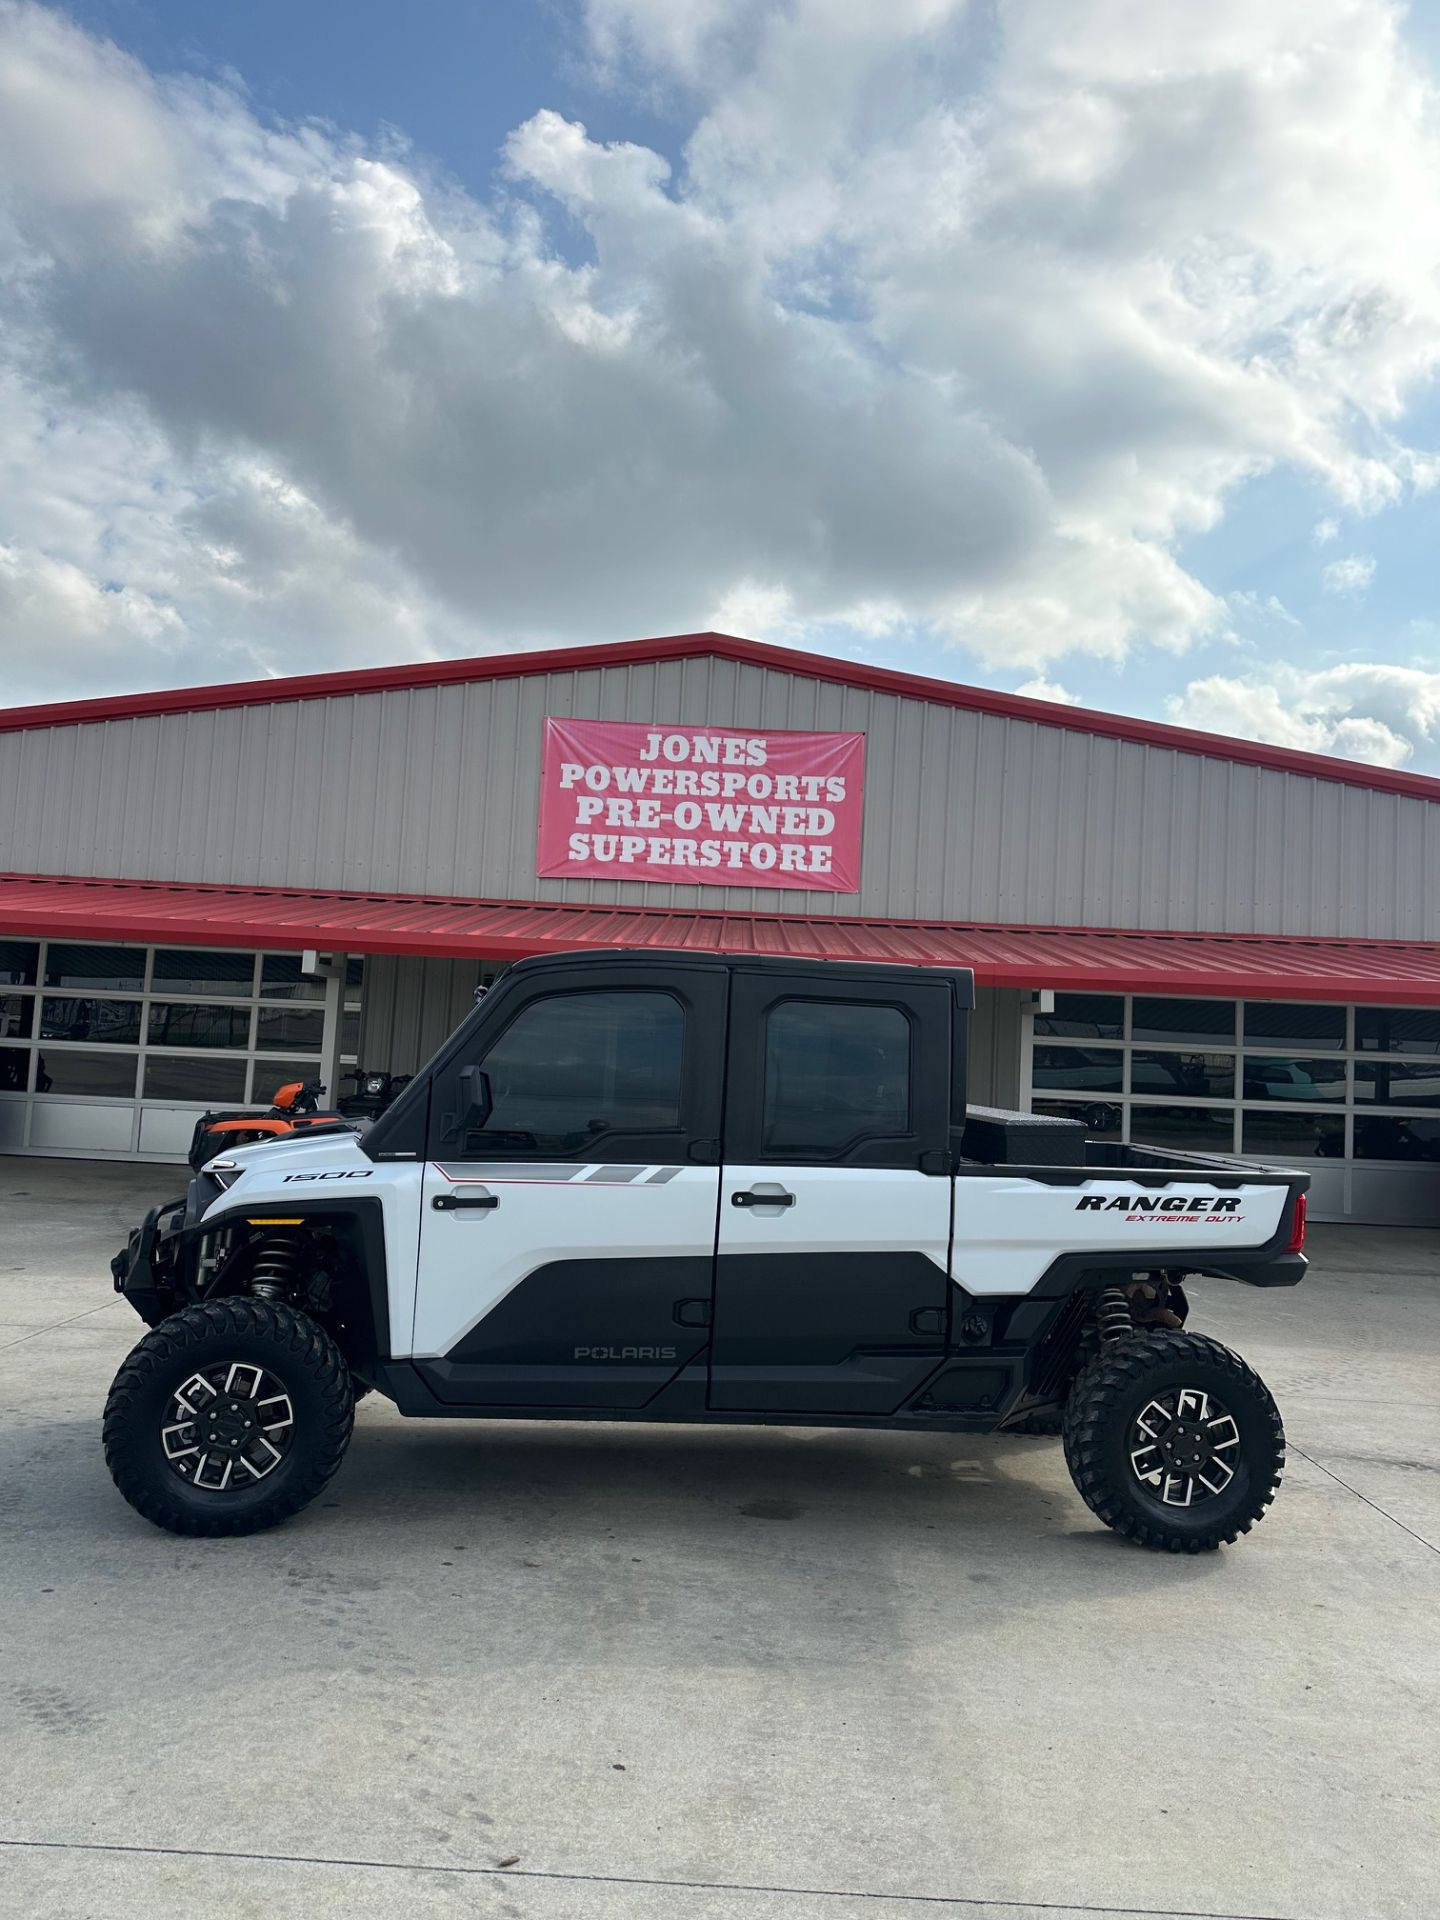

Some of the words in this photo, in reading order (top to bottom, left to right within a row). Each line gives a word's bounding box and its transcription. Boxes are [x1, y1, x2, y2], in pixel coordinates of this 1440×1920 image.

[640, 733, 768, 766] JONES
[559, 763, 847, 803] POWERSPORTS
[575, 796, 836, 837] PRE-OWNED
[568, 833, 833, 873] SUPERSTORE
[282, 1170, 375, 1183] 1500
[1075, 1195, 1242, 1212] RANGER
[1125, 1215, 1202, 1223] EXTREME
[1204, 1215, 1246, 1223] DUTY
[574, 1346, 677, 1359] POLARIS
